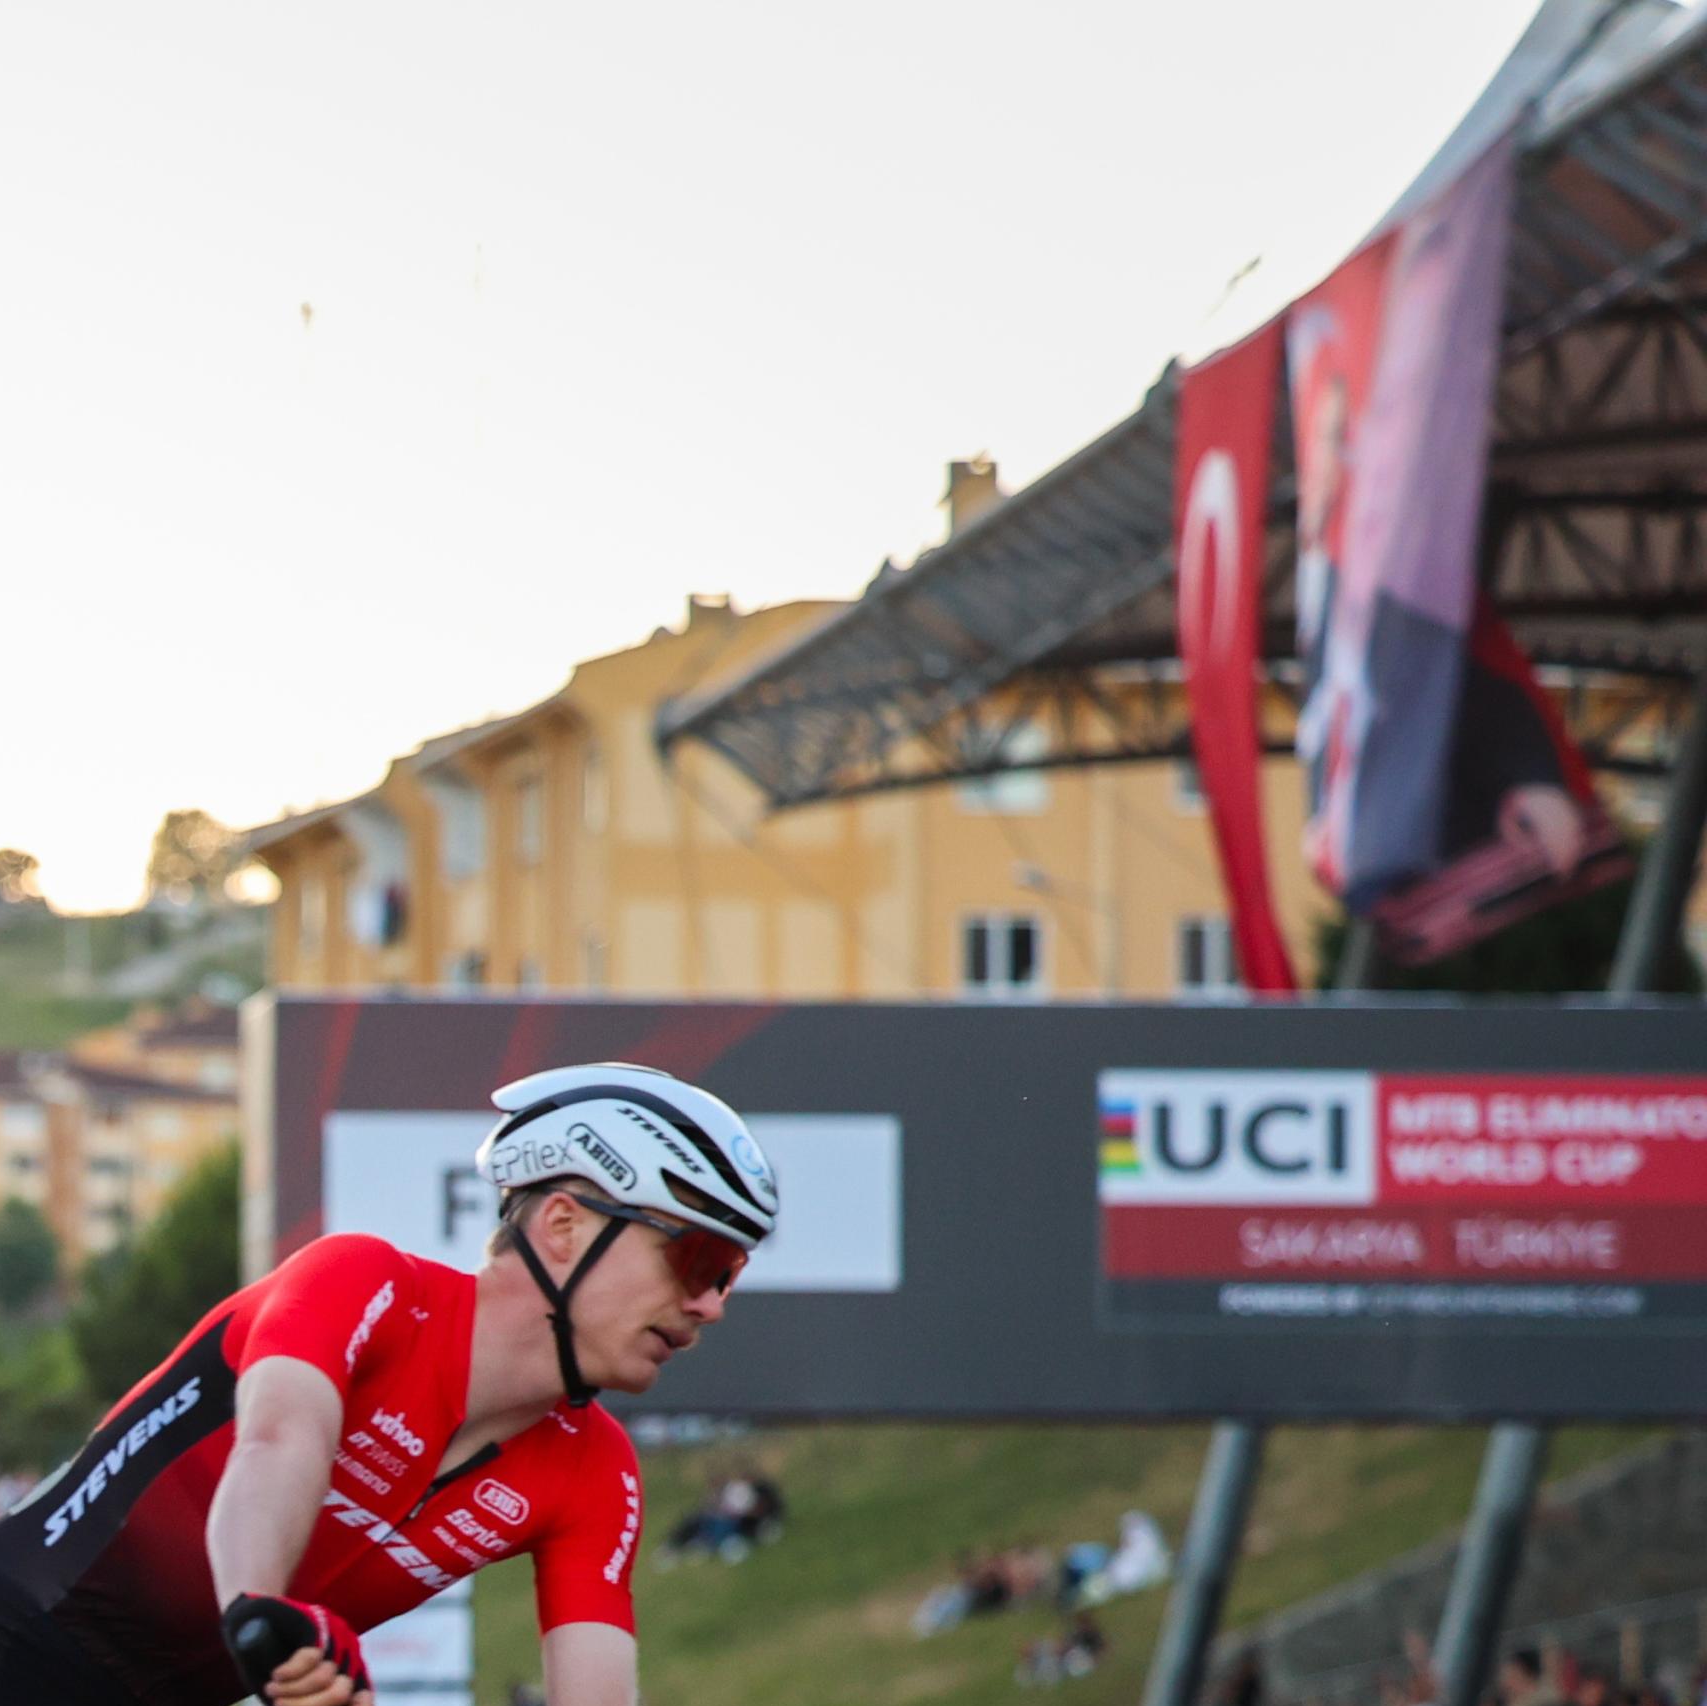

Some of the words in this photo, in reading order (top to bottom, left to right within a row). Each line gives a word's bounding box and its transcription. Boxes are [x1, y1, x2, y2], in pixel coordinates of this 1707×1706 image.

[576, 1132, 628, 1182] ABUS
[616, 1107, 706, 1174] STEVENS
[1155, 1104, 1348, 1175] UCI
[1390, 1143, 1545, 1185] WORLD
[1552, 1143, 1643, 1185] CUP
[44, 1377, 203, 1548] STEVENS
